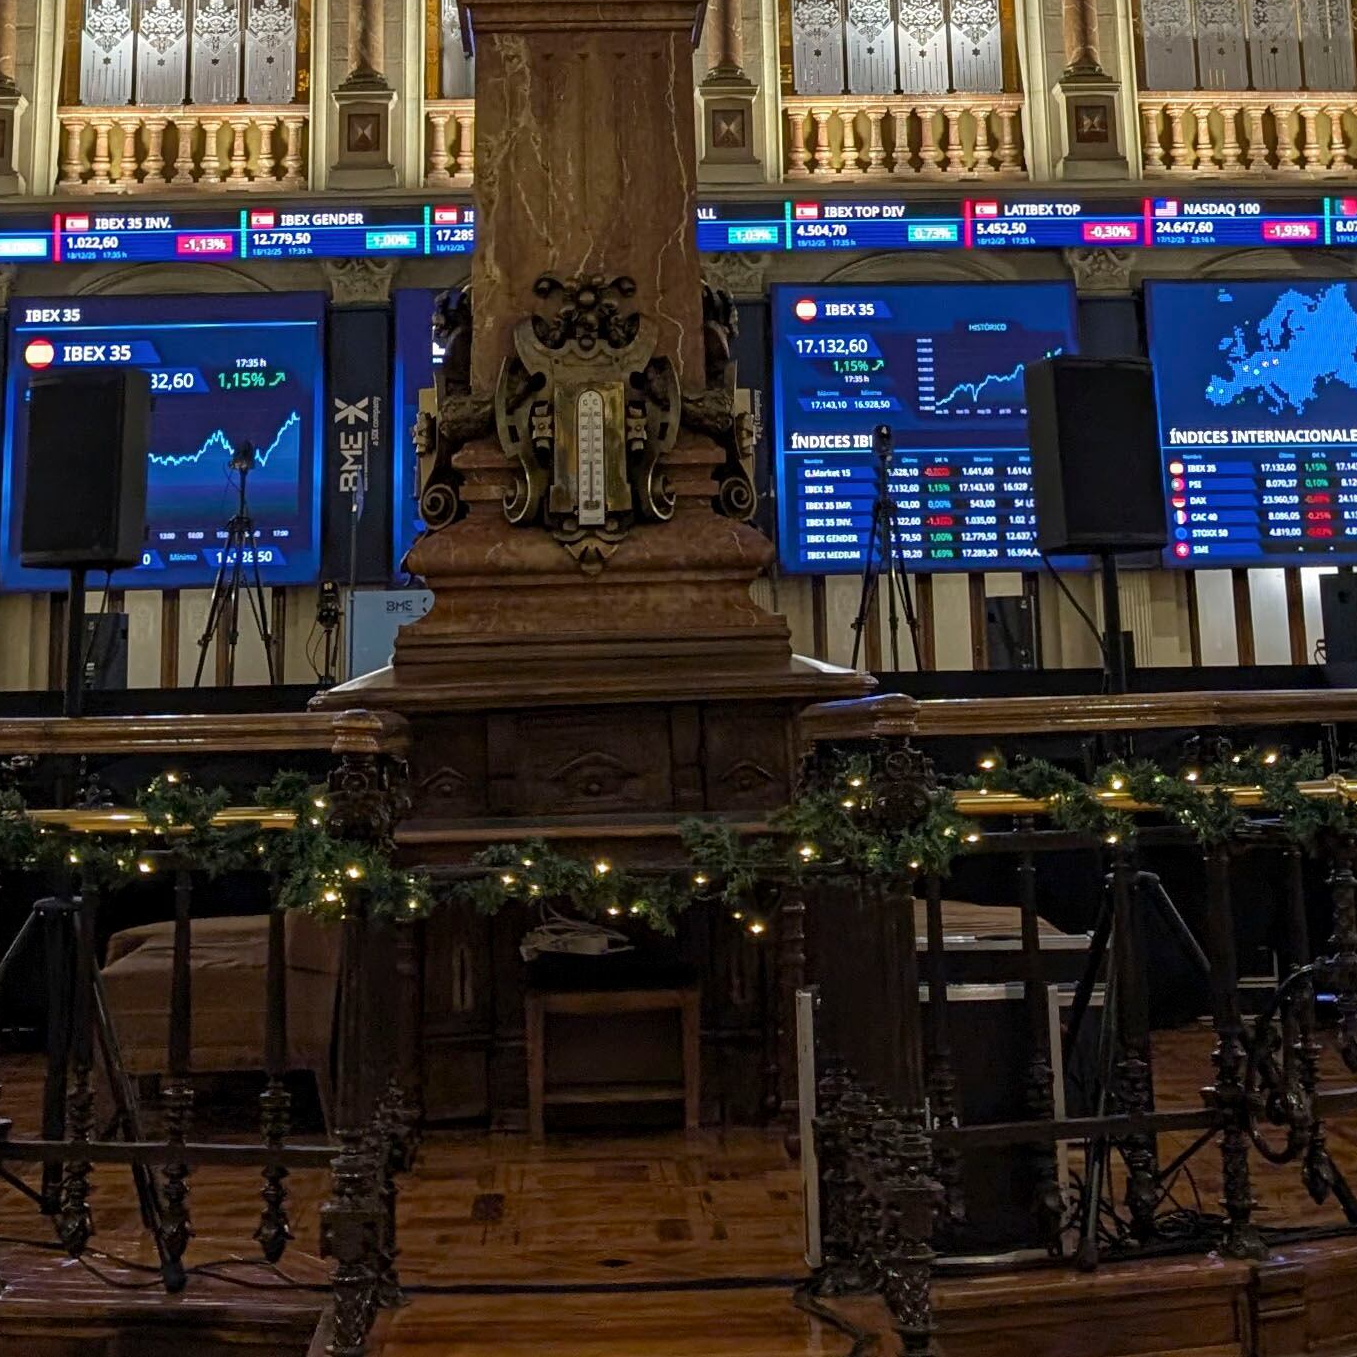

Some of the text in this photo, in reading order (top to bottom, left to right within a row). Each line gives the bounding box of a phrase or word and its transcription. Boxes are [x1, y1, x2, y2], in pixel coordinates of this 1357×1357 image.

[824, 206, 905, 217] IBEX TOP DIV
[1004, 204, 1081, 216] LATIBEX TOP
[1184, 203, 1260, 216] NASDAQ 100
[95, 217, 172, 230] IBEX 35 INV.
[281, 214, 364, 226] IBEX GENDER
[797, 225, 847, 237] 4.504,70
[977, 223, 1131, 237] 5.452,50 -0,30%
[1155, 221, 1311, 237] 24.647,60 -1,93%
[67, 237, 118, 250] 1.022,60
[253, 233, 311, 246] 12.779,50
[825, 303, 875, 316] IBEX 35
[25, 309, 81, 323] IBEX 35
[797, 339, 868, 355] 17.132,60
[63, 345, 131, 362] IBEX 35
[235, 359, 258, 368] 17:35
[834, 360, 869, 373] 1,15%
[151, 373, 266, 390] 32,60 1,15%
[811, 401, 890, 409] 17.143,10 16.928,50
[372, 396, 381, 428] company
[791, 432, 850, 449] ÍNDICES
[1169, 428, 1228, 444] ÍNDICES
[340, 431, 362, 492] BME
[1187, 464, 1205, 473] IBEX
[1207, 464, 1217, 472] 35
[1261, 463, 1297, 472] 17.132,60
[804, 485, 823, 494] IBEX
[825, 484, 834, 493] 35
[805, 501, 824, 510] IBEX
[826, 501, 835, 510] 35
[970, 500, 996, 508] 543,00
[1190, 496, 1206, 504] DAX
[806, 518, 825, 527] IBEX
[826, 518, 835, 526] 35
[1191, 513, 1208, 521] CAC
[806, 534, 826, 543] IBEX
[827, 533, 858, 543] GENDER
[1192, 529, 1217, 538] STOXX
[807, 550, 826, 560] IBEX
[386, 600, 413, 612] BME
